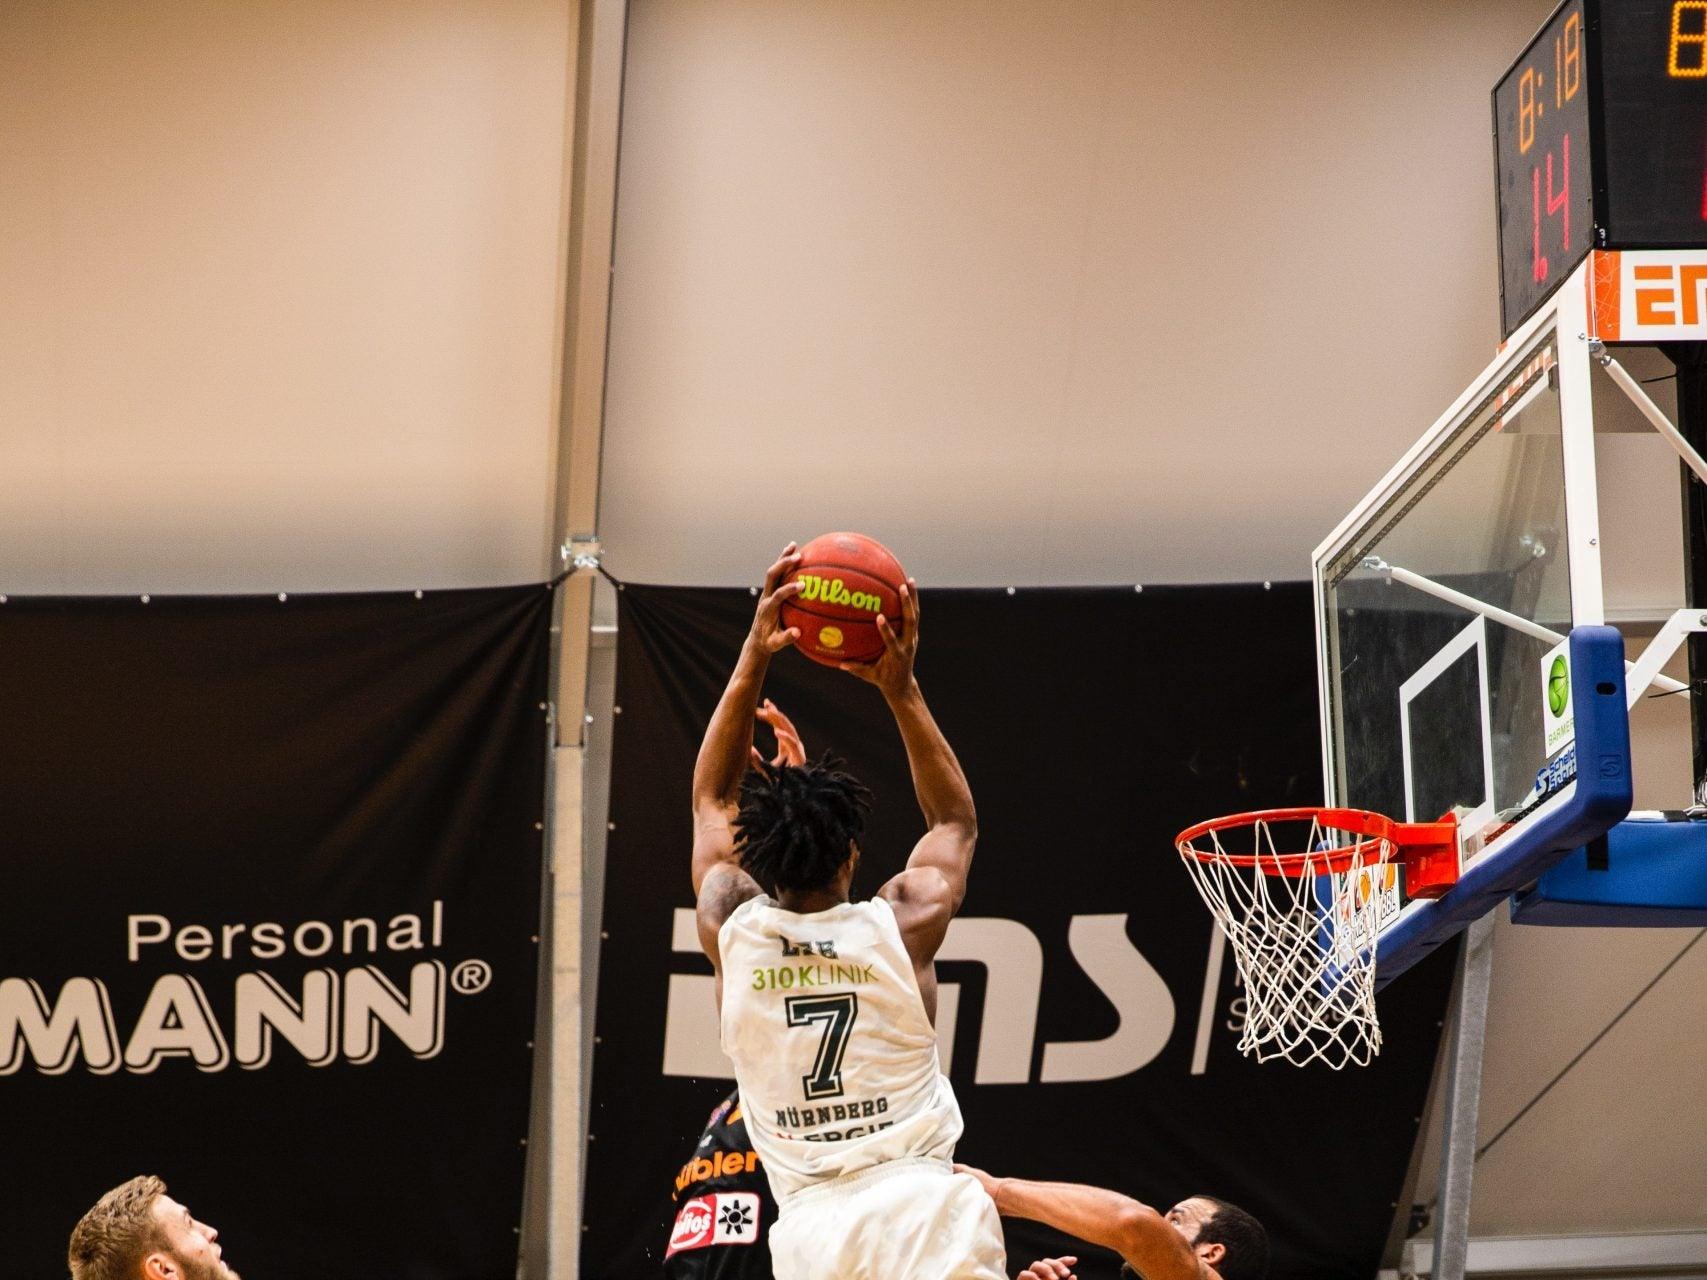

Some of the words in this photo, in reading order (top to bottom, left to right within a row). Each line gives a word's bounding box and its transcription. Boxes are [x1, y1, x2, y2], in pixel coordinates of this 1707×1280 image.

[798, 574, 881, 613] Wilson
[127, 900, 443, 962] Personal
[784, 992, 858, 1101] 7
[775, 1097, 889, 1128] NÜRNBERG
